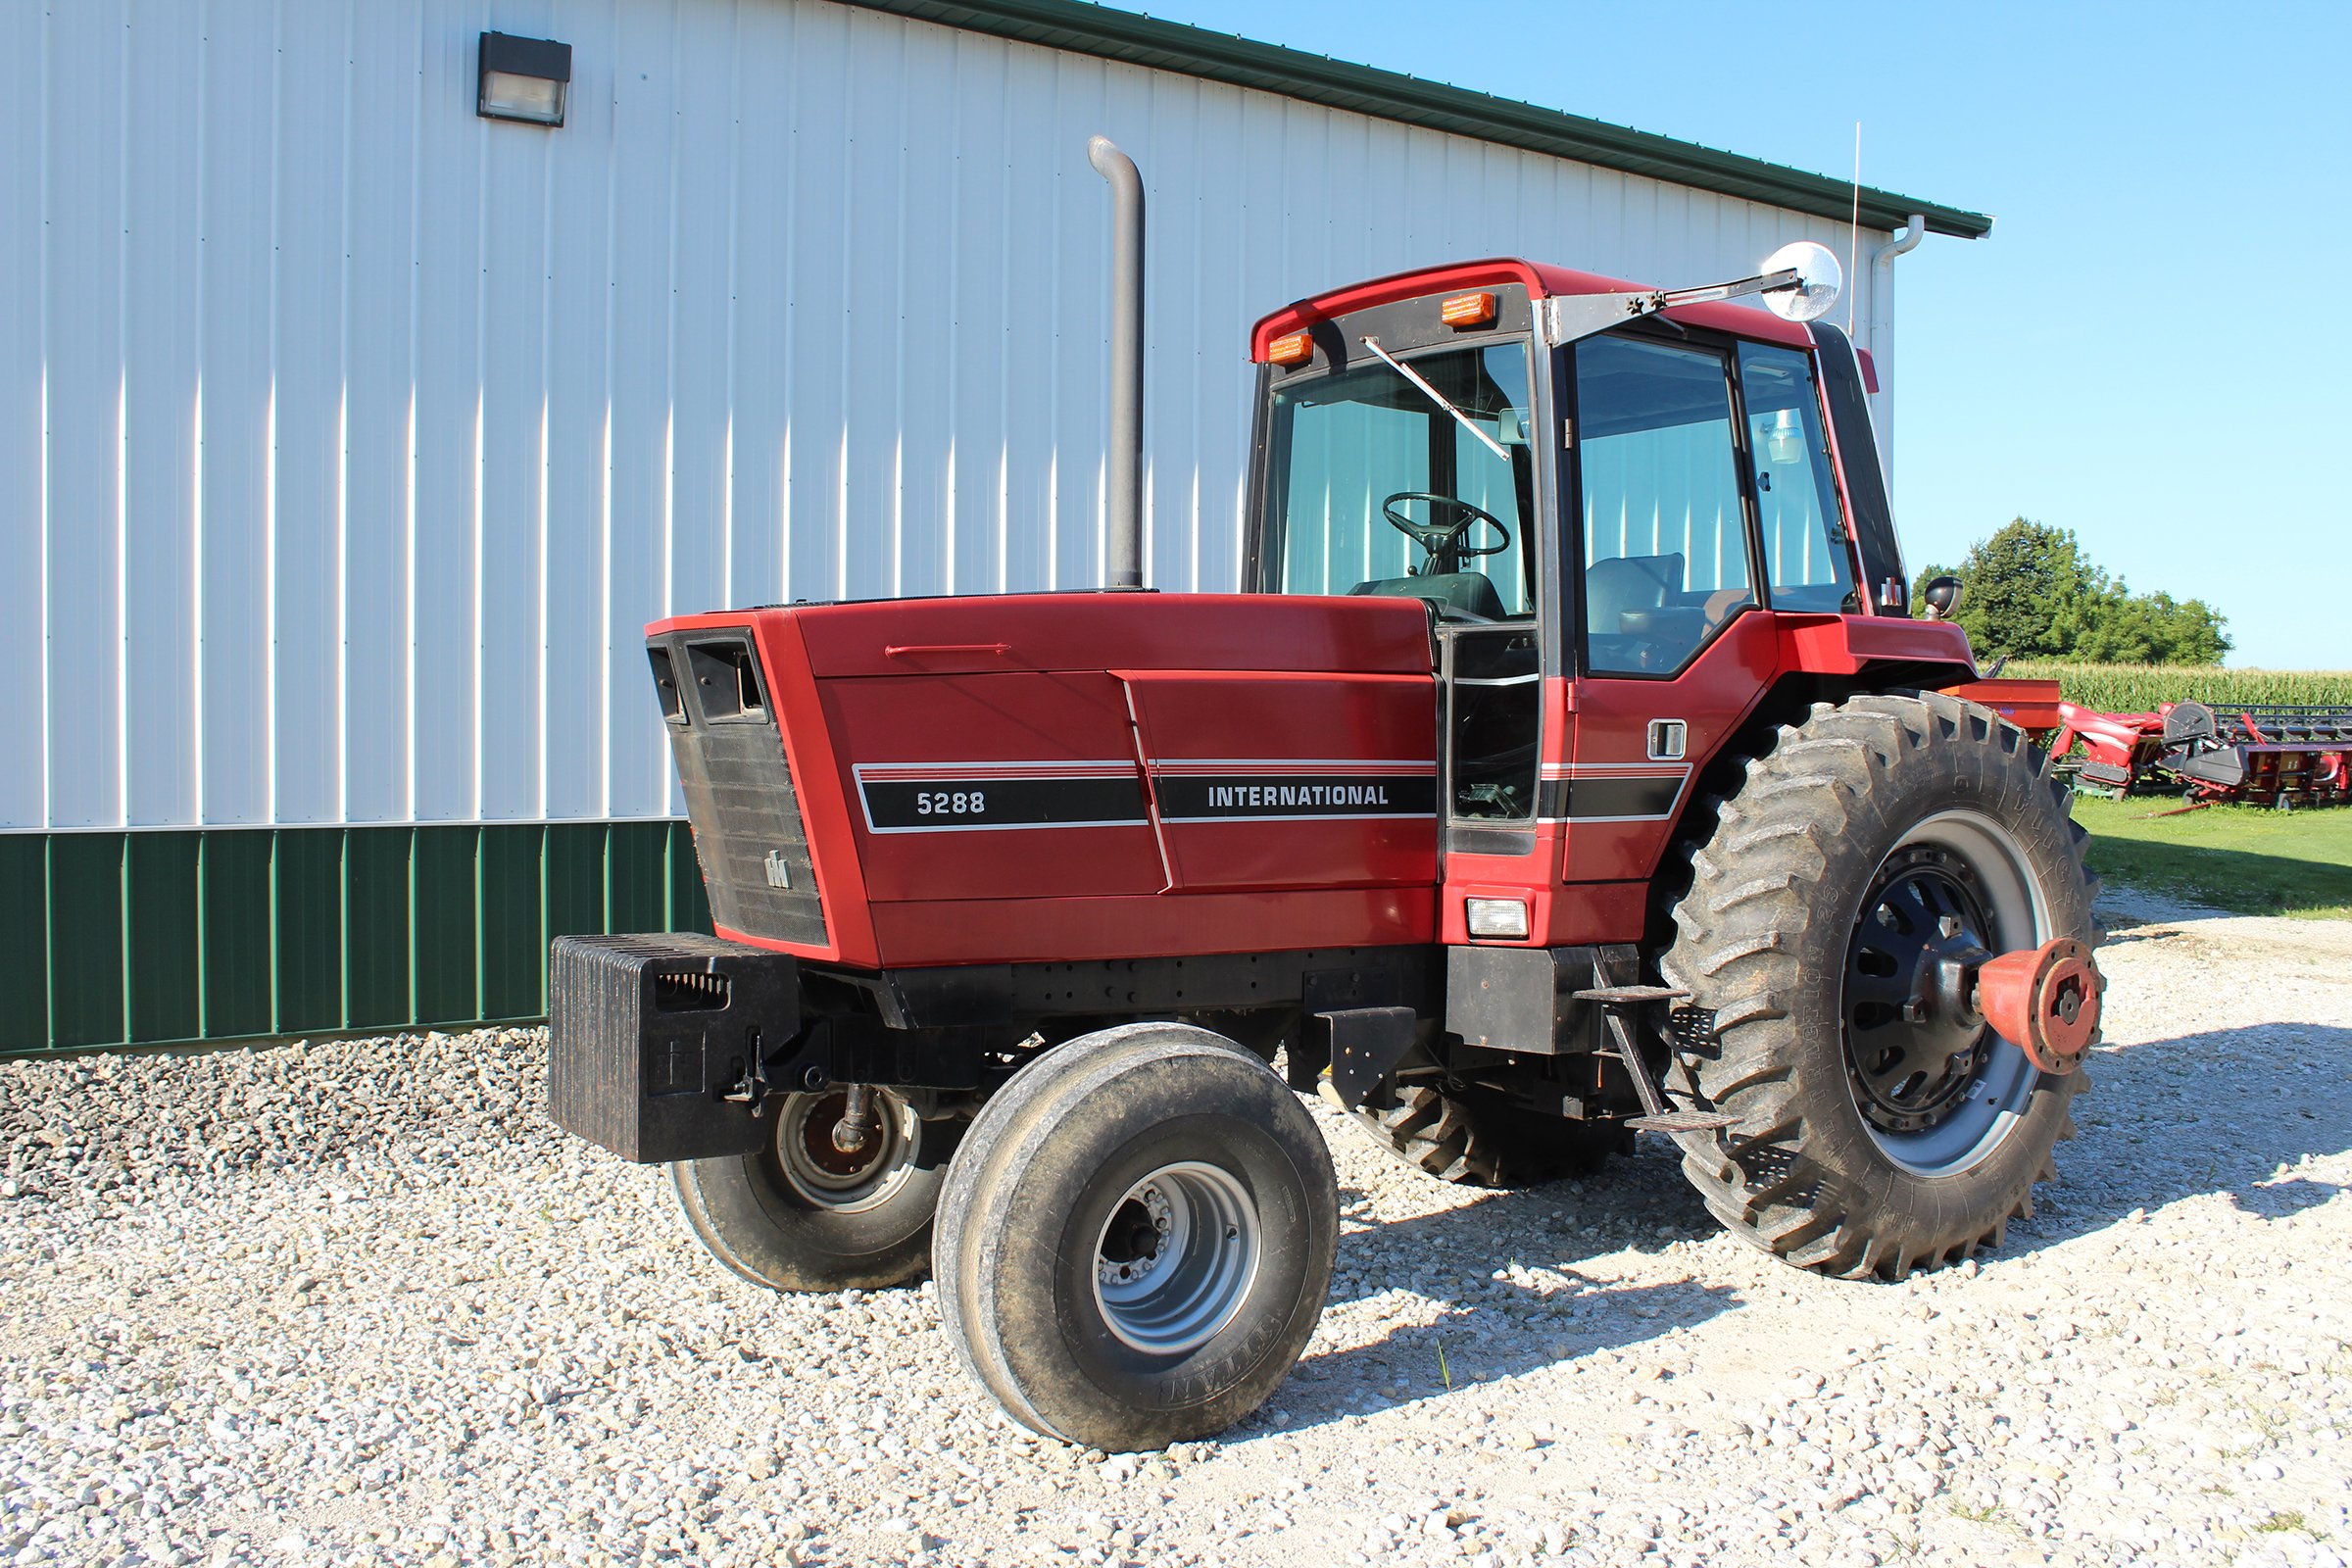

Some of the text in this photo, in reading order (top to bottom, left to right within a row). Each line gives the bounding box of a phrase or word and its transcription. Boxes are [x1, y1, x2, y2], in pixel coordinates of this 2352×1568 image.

[917, 791, 985, 814] 5288
[1208, 786, 1389, 807] INTERNATIONAL
[1802, 945, 1828, 1106] TRACTION
[1165, 1318, 1273, 1403] TITAN
